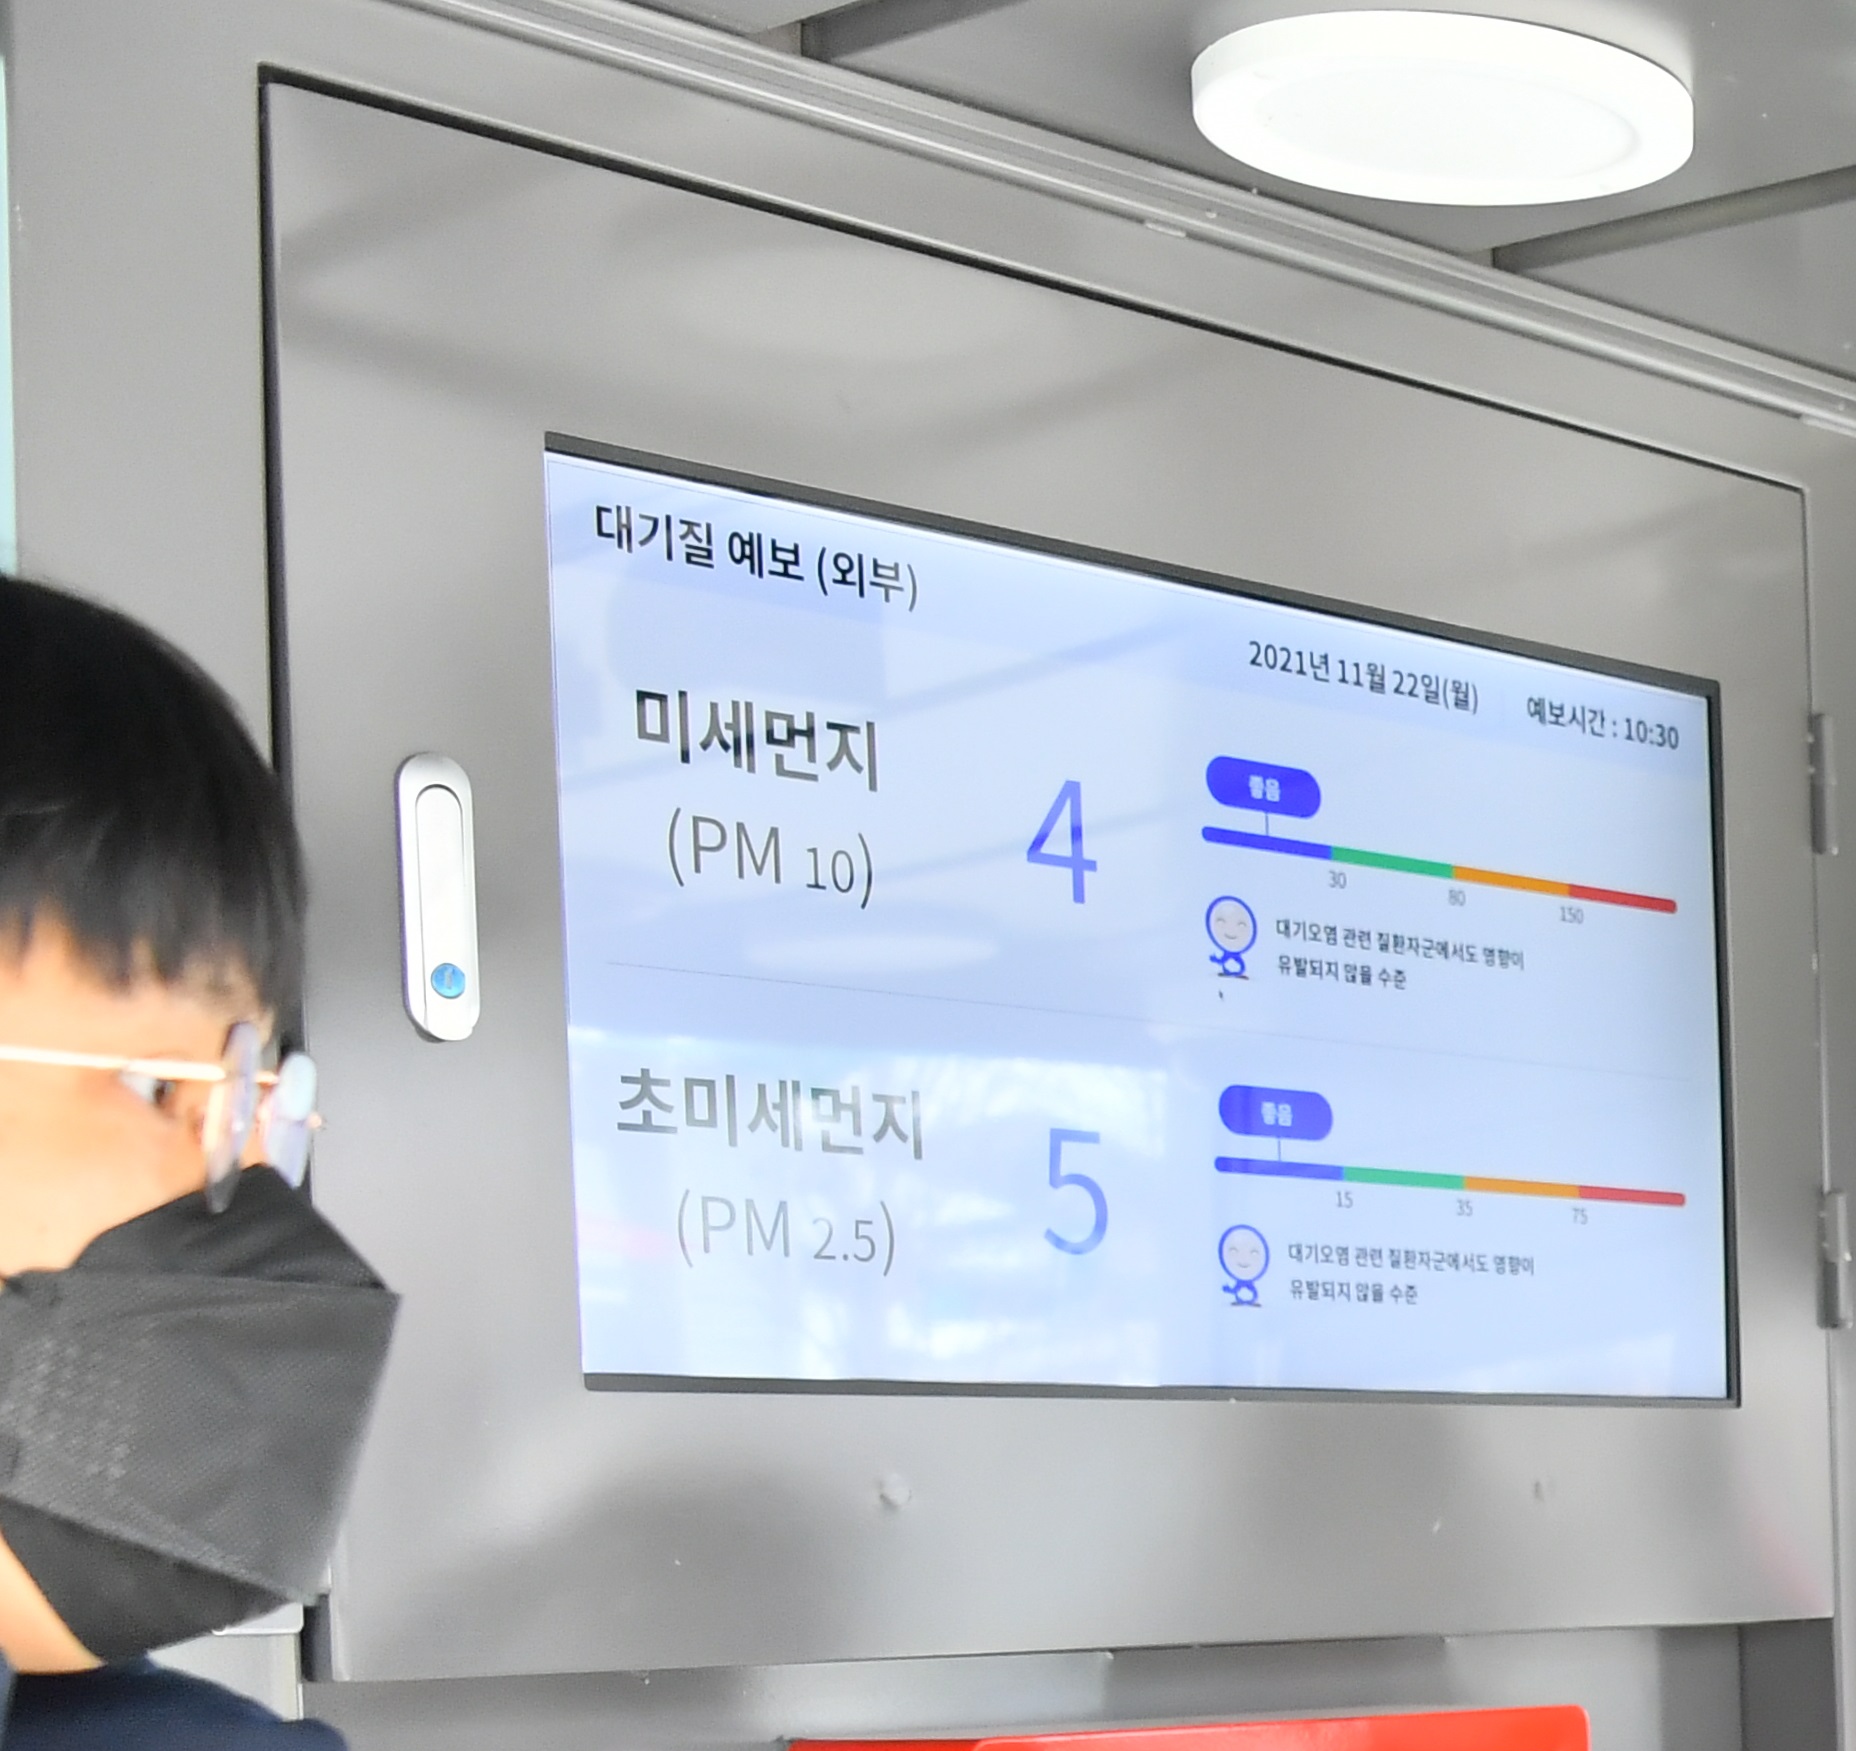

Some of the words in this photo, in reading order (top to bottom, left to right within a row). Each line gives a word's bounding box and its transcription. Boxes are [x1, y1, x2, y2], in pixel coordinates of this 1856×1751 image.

[596, 505, 715, 567] 대기질
[727, 529, 804, 581] 예보
[817, 546, 918, 612] (외부)
[1249, 641, 1331, 684] 2021년
[1337, 658, 1386, 695] 11월
[1392, 669, 1479, 715] 22일(월)
[636, 689, 878, 792] 미세먼지
[1527, 696, 1606, 738] 예보시간
[1624, 718, 1680, 750] 10:30
[668, 807, 782, 885] (PM
[805, 832, 873, 910] 10)
[1027, 780, 1098, 904] 4
[1328, 870, 1347, 889] 30
[1448, 889, 1466, 907] 80
[1559, 906, 1584, 925] 150
[1276, 918, 1339, 947] 대기오염
[1342, 927, 1373, 952] 관련
[1277, 954, 1340, 983] 유발되지
[1378, 968, 1408, 990] 수준
[616, 1067, 924, 1160] 초미세먼지
[1043, 1127, 1109, 1256] 5
[1336, 1191, 1354, 1208] 15
[1457, 1200, 1474, 1217] 35
[677, 1188, 791, 1268] (PM
[812, 1201, 896, 1276] 2.5)
[1572, 1208, 1588, 1225] 75
[1288, 1243, 1350, 1267] 대기오염
[1354, 1247, 1384, 1269] 관련
[1290, 1279, 1351, 1302] 유발되지
[1389, 1284, 1419, 1305] 수준
